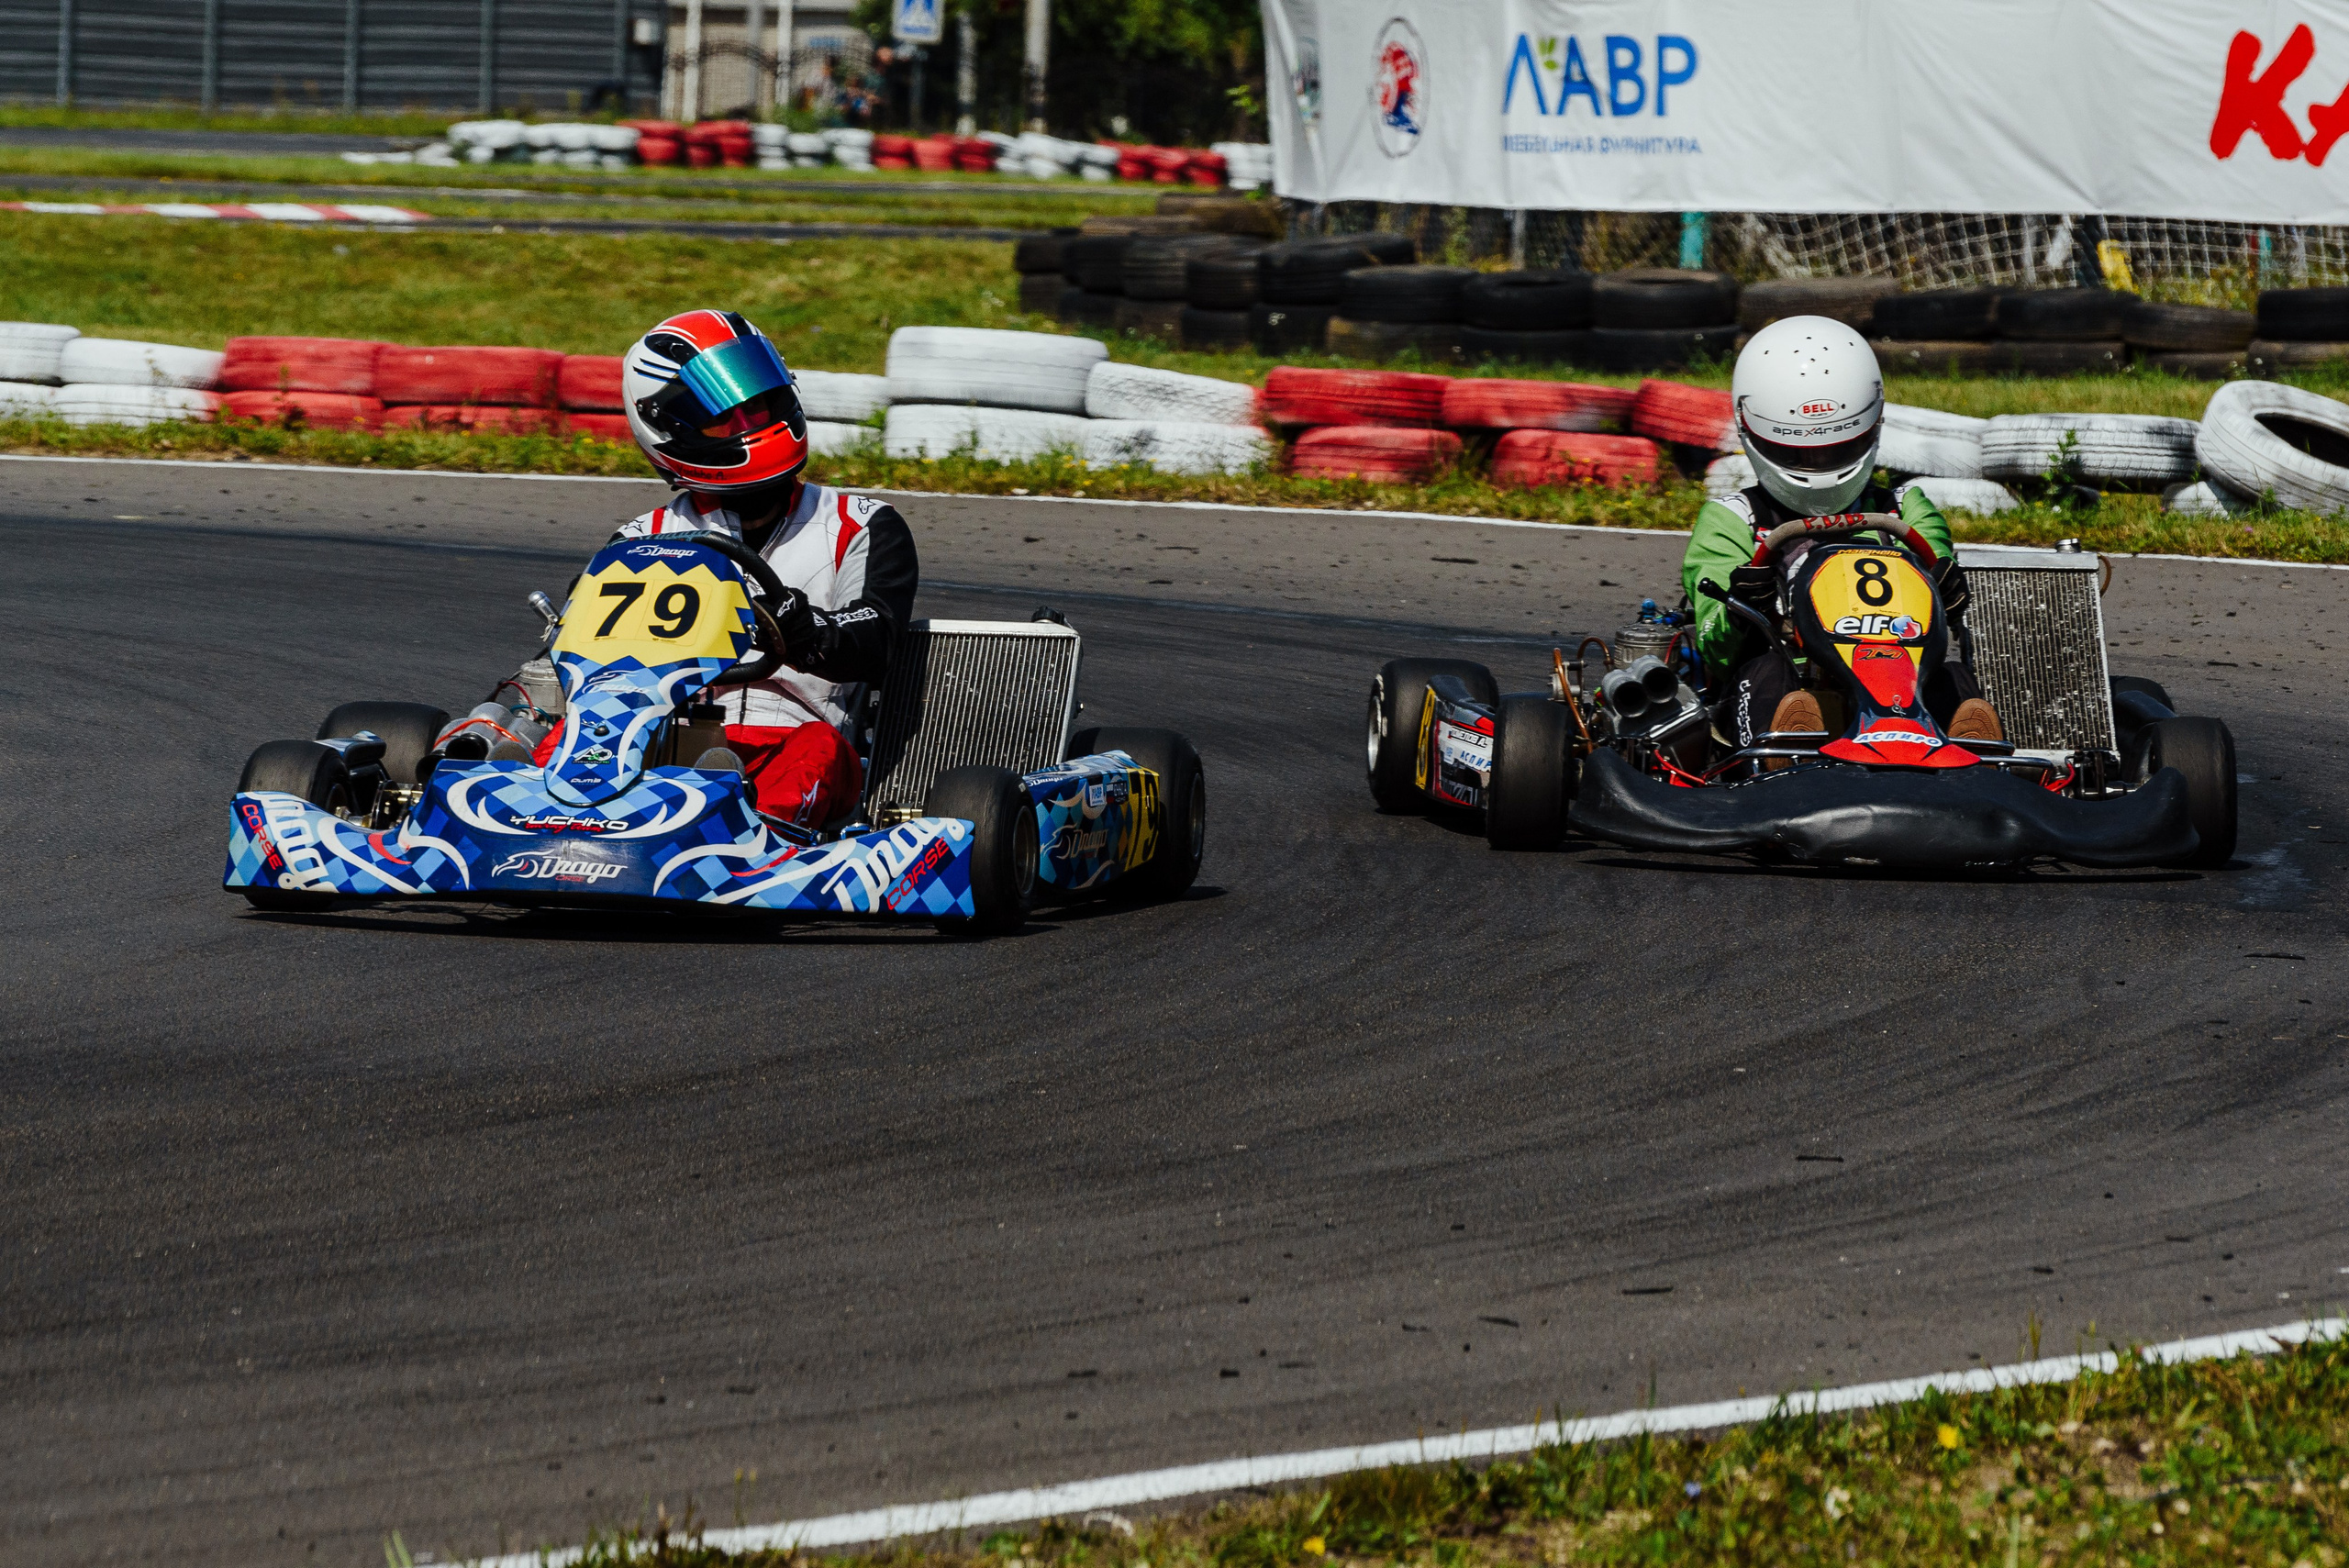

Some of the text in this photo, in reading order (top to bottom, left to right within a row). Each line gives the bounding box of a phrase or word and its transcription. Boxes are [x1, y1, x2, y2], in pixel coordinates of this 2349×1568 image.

[1803, 404, 1834, 414] BELL
[1773, 419, 1861, 437] apex4race
[650, 547, 698, 558] Drago
[1854, 558, 1893, 607] 8
[595, 582, 700, 639] 79
[1834, 616, 1890, 635] elf
[1857, 733, 1940, 745] АСПИРО
[510, 815, 629, 831] YUCHKO
[1129, 770, 1160, 868] 79
[242, 804, 283, 871] CORSE
[1070, 828, 1109, 859] Drago
[537, 856, 629, 884] Drago
[886, 836, 950, 911] CORSE
